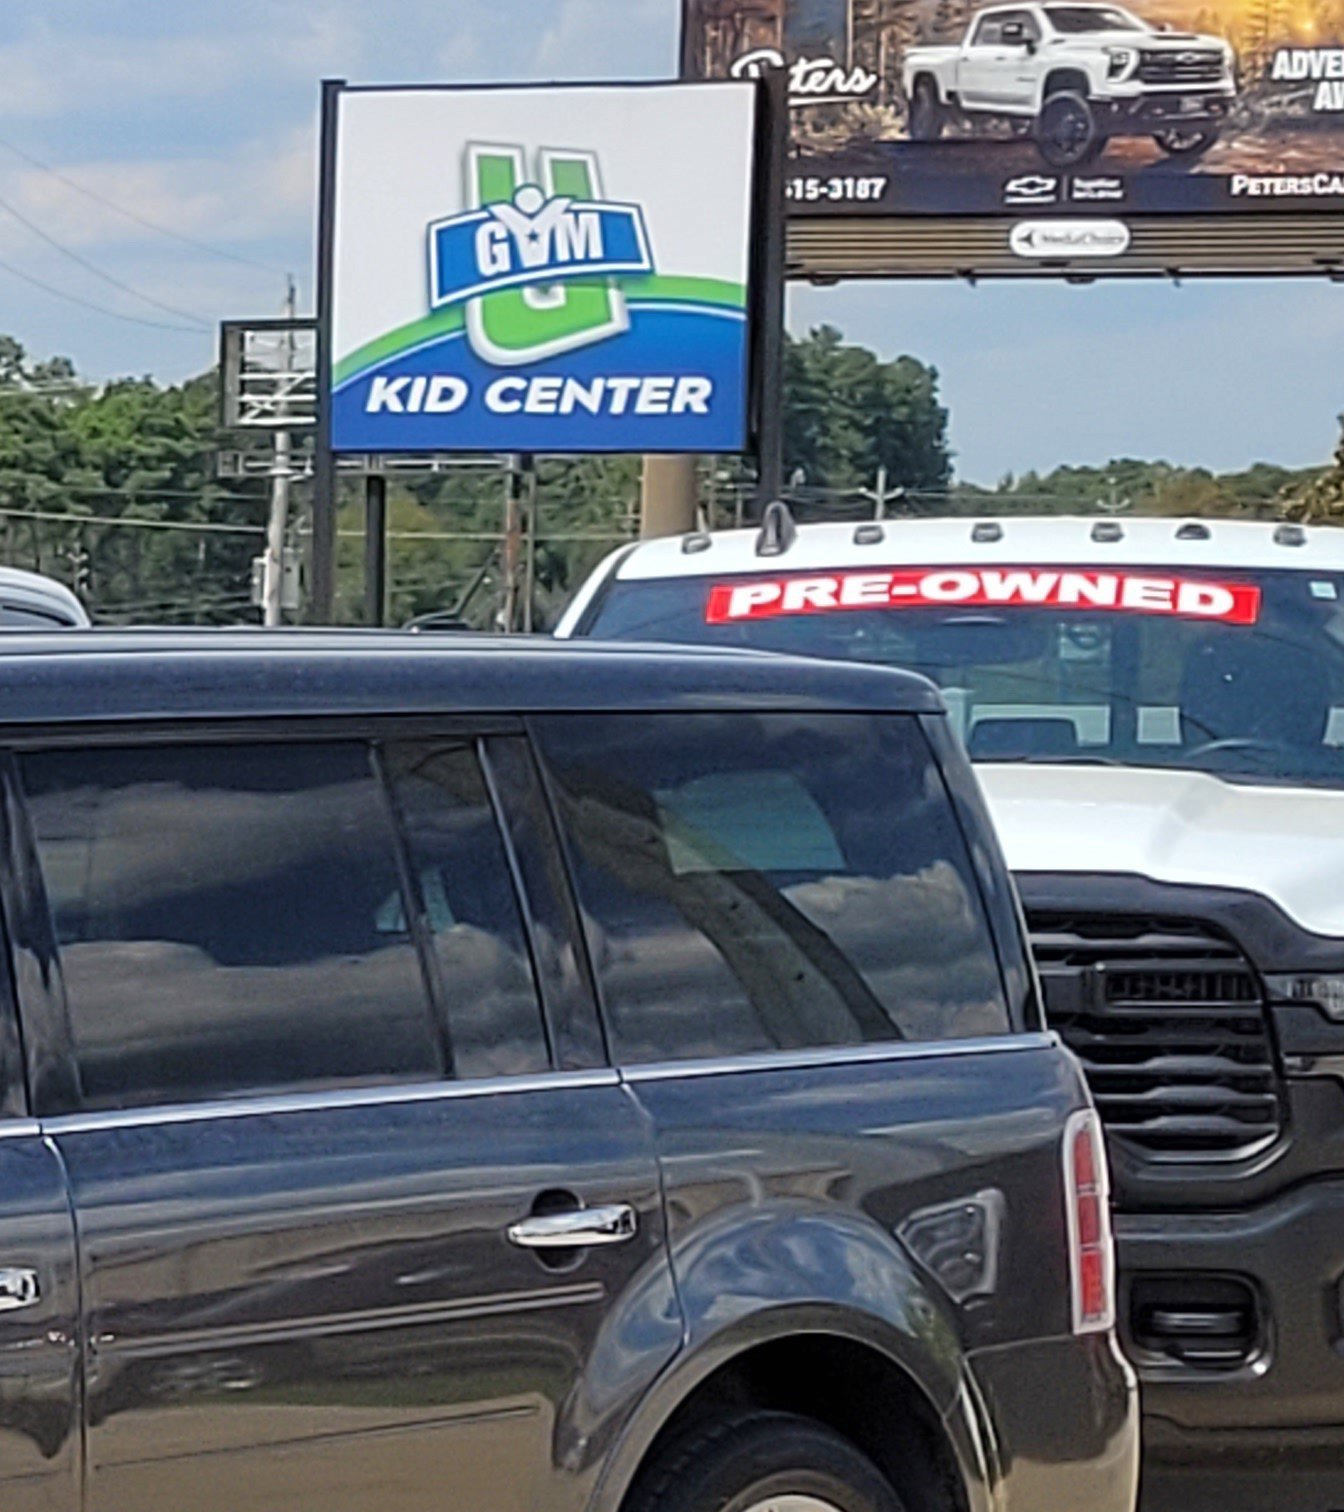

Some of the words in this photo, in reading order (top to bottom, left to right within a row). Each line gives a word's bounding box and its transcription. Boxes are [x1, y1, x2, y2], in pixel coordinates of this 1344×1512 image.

[474, 203, 604, 277] GYM
[364, 376, 469, 414] KID
[484, 376, 712, 415] CENTER
[728, 572, 1236, 616] PRE-OWNED
